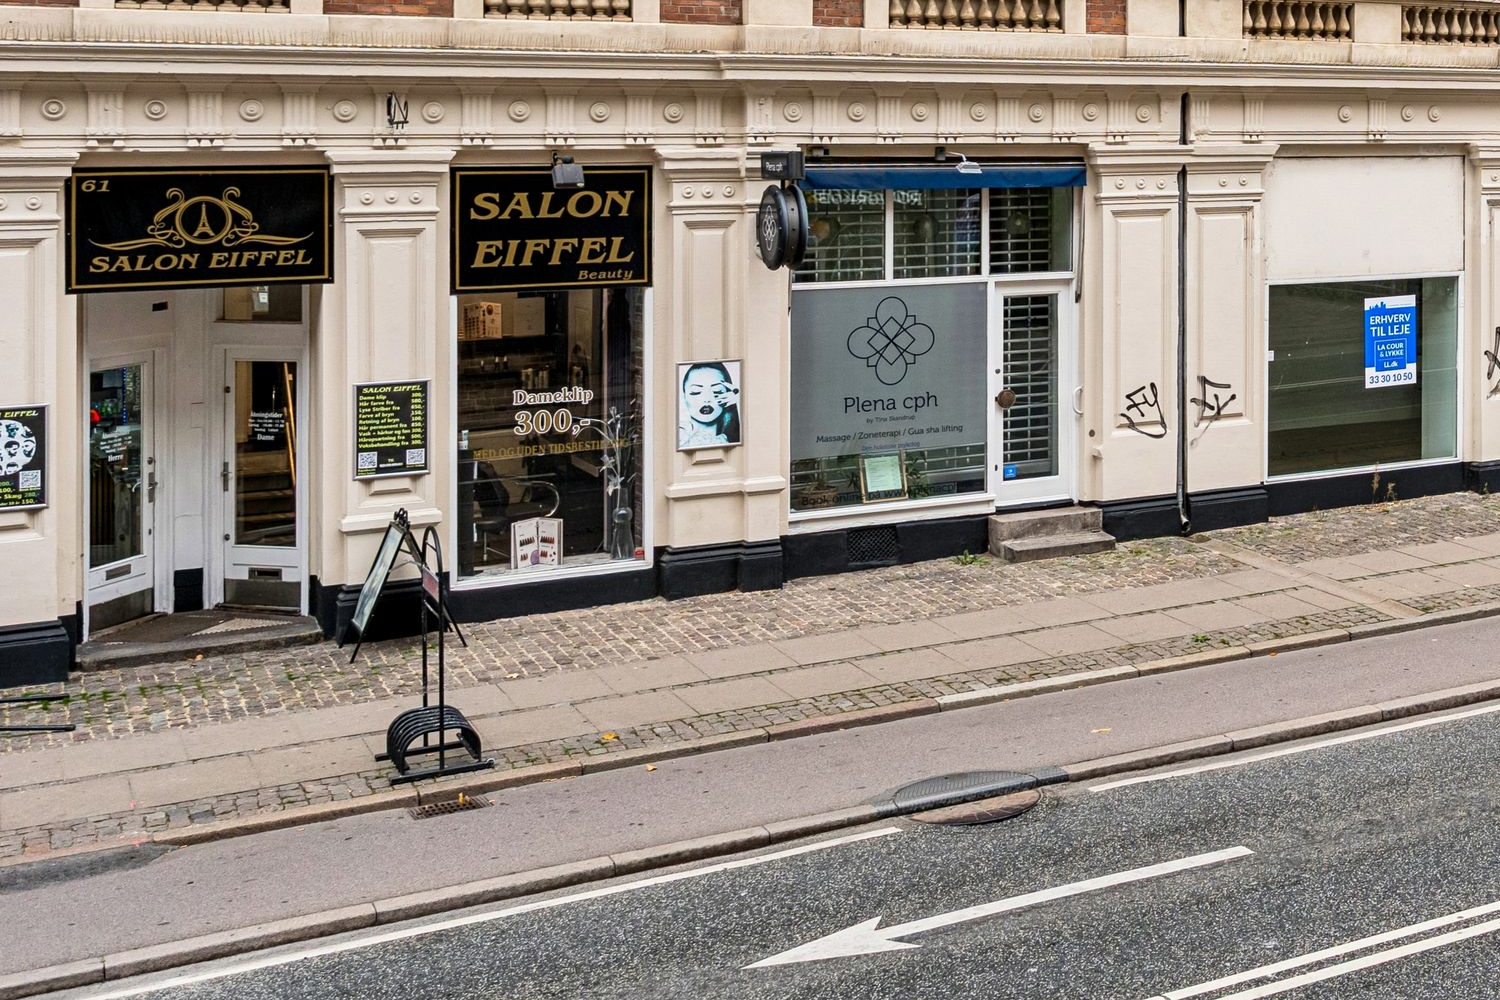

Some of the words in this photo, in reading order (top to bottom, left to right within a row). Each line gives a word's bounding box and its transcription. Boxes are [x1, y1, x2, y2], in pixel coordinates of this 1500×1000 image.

[81, 180, 111, 192] 61
[470, 190, 635, 221] SALON
[470, 236, 635, 269] EIFFEL
[88, 253, 200, 273] SALON
[208, 249, 314, 269] EIFFEL
[578, 270, 633, 281] Beauty
[1370, 312, 1411, 325] ERHVERV
[1370, 326, 1386, 338] TIL
[1388, 324, 1410, 336] LEJE
[1386, 342, 1404, 350] COUR
[1369, 376, 1379, 384] 33
[1381, 374, 1391, 383] 30
[1393, 373, 1402, 382] 10
[1403, 372, 1412, 380] 50
[512, 385, 594, 406] Dameklip
[844, 396, 897, 414] Plena
[902, 392, 938, 412] cph
[4, 410, 39, 418] EIFFEL
[889, 414, 916, 422] Skandrup
[514, 408, 590, 436] 300,-
[816, 434, 851, 443] Massage
[858, 430, 901, 440] Zoneterapi
[908, 427, 924, 436] Gua
[926, 425, 939, 434] sha
[941, 424, 964, 433] lifting
[499, 448, 514, 457] OG
[518, 444, 546, 456] UDEN
[802, 495, 826, 506] Book
